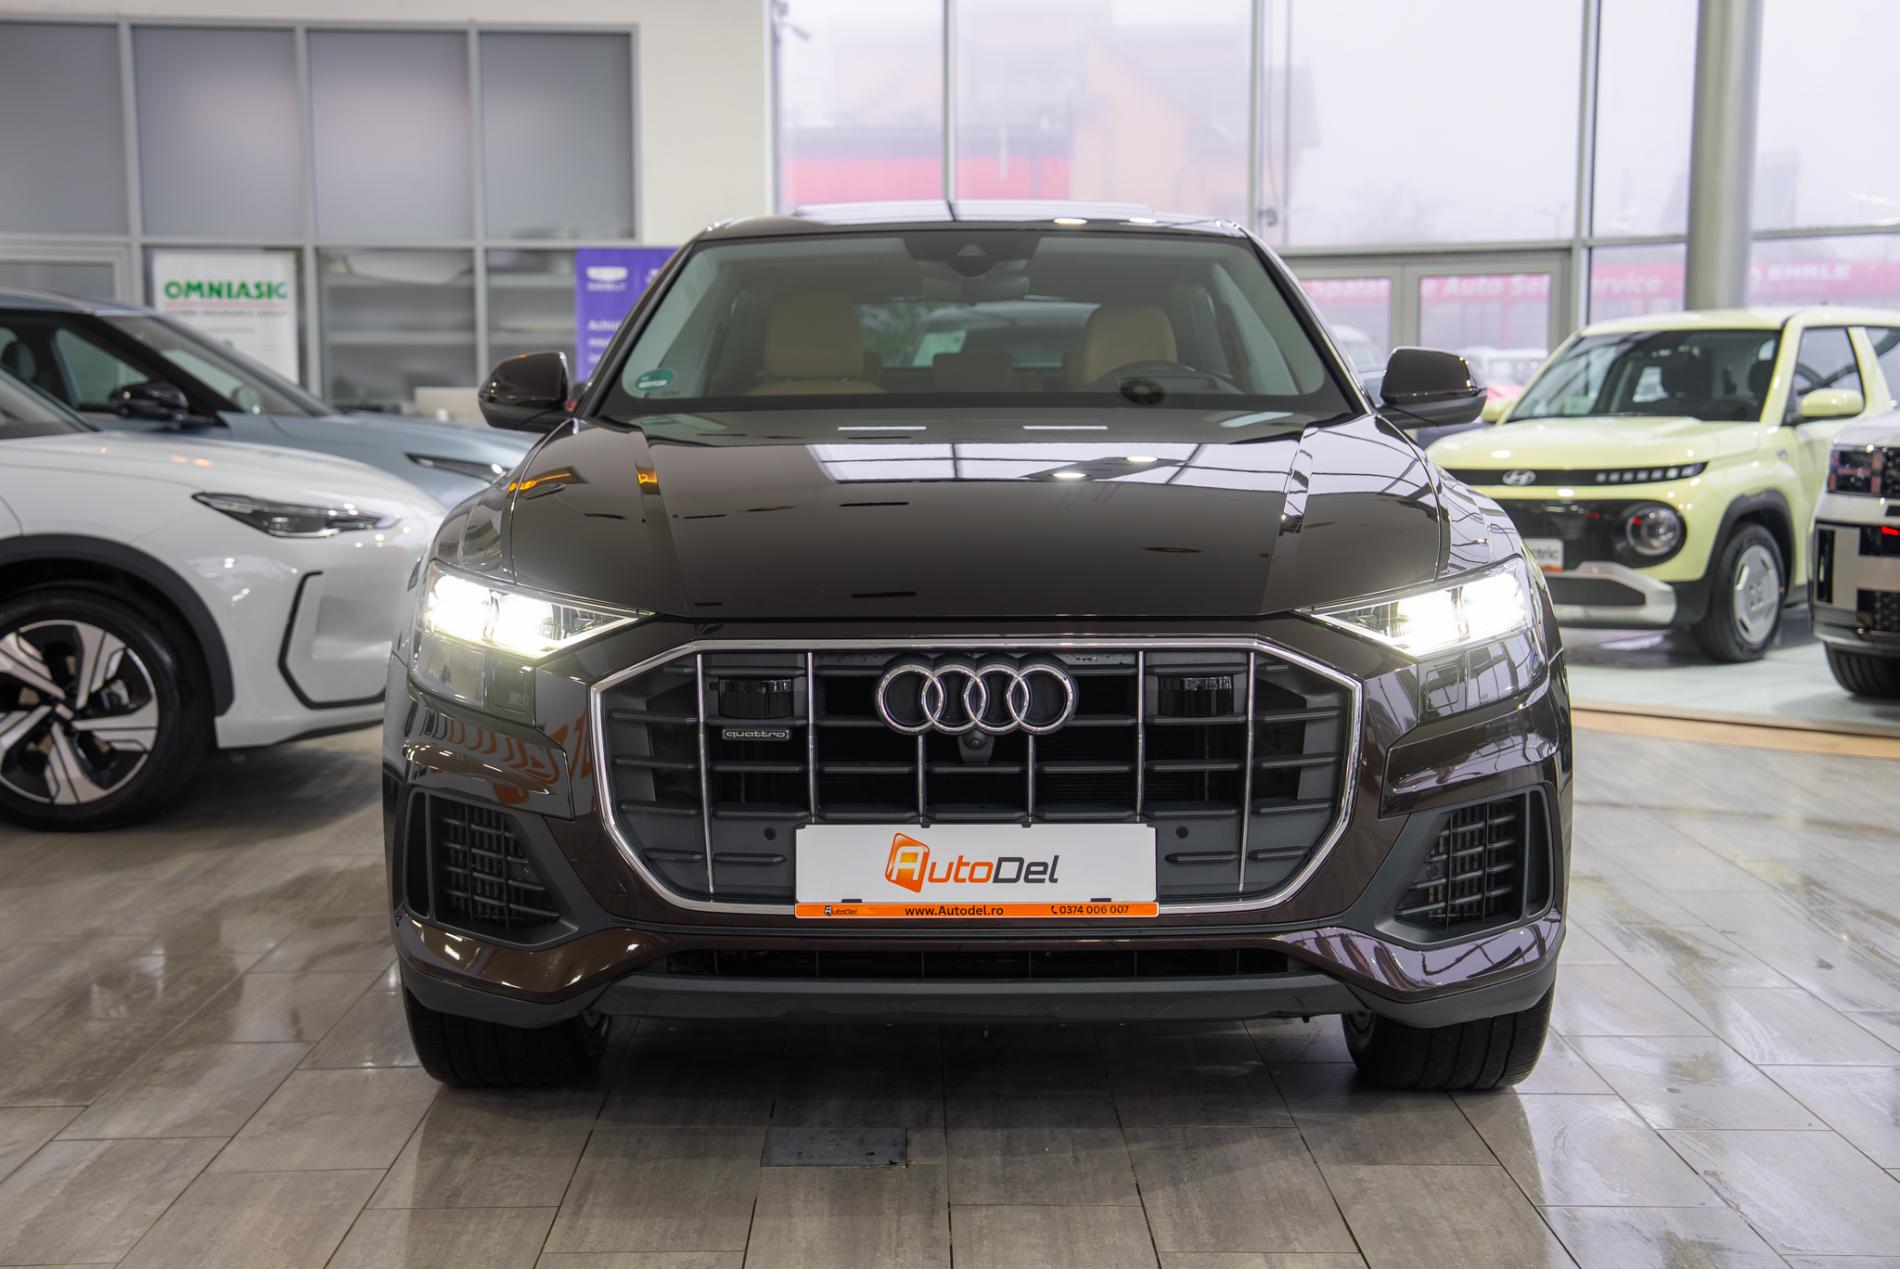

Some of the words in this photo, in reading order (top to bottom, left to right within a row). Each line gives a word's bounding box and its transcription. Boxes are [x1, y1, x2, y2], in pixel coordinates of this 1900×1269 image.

[1442, 277, 1504, 296] Auto
[726, 730, 786, 738] quattro
[888, 844, 1060, 884] AutoDel
[904, 905, 1004, 916] www.Autodel.ro
[1060, 905, 1083, 915] 0374
[1086, 905, 1107, 914] 006
[1110, 905, 1129, 914] 007
